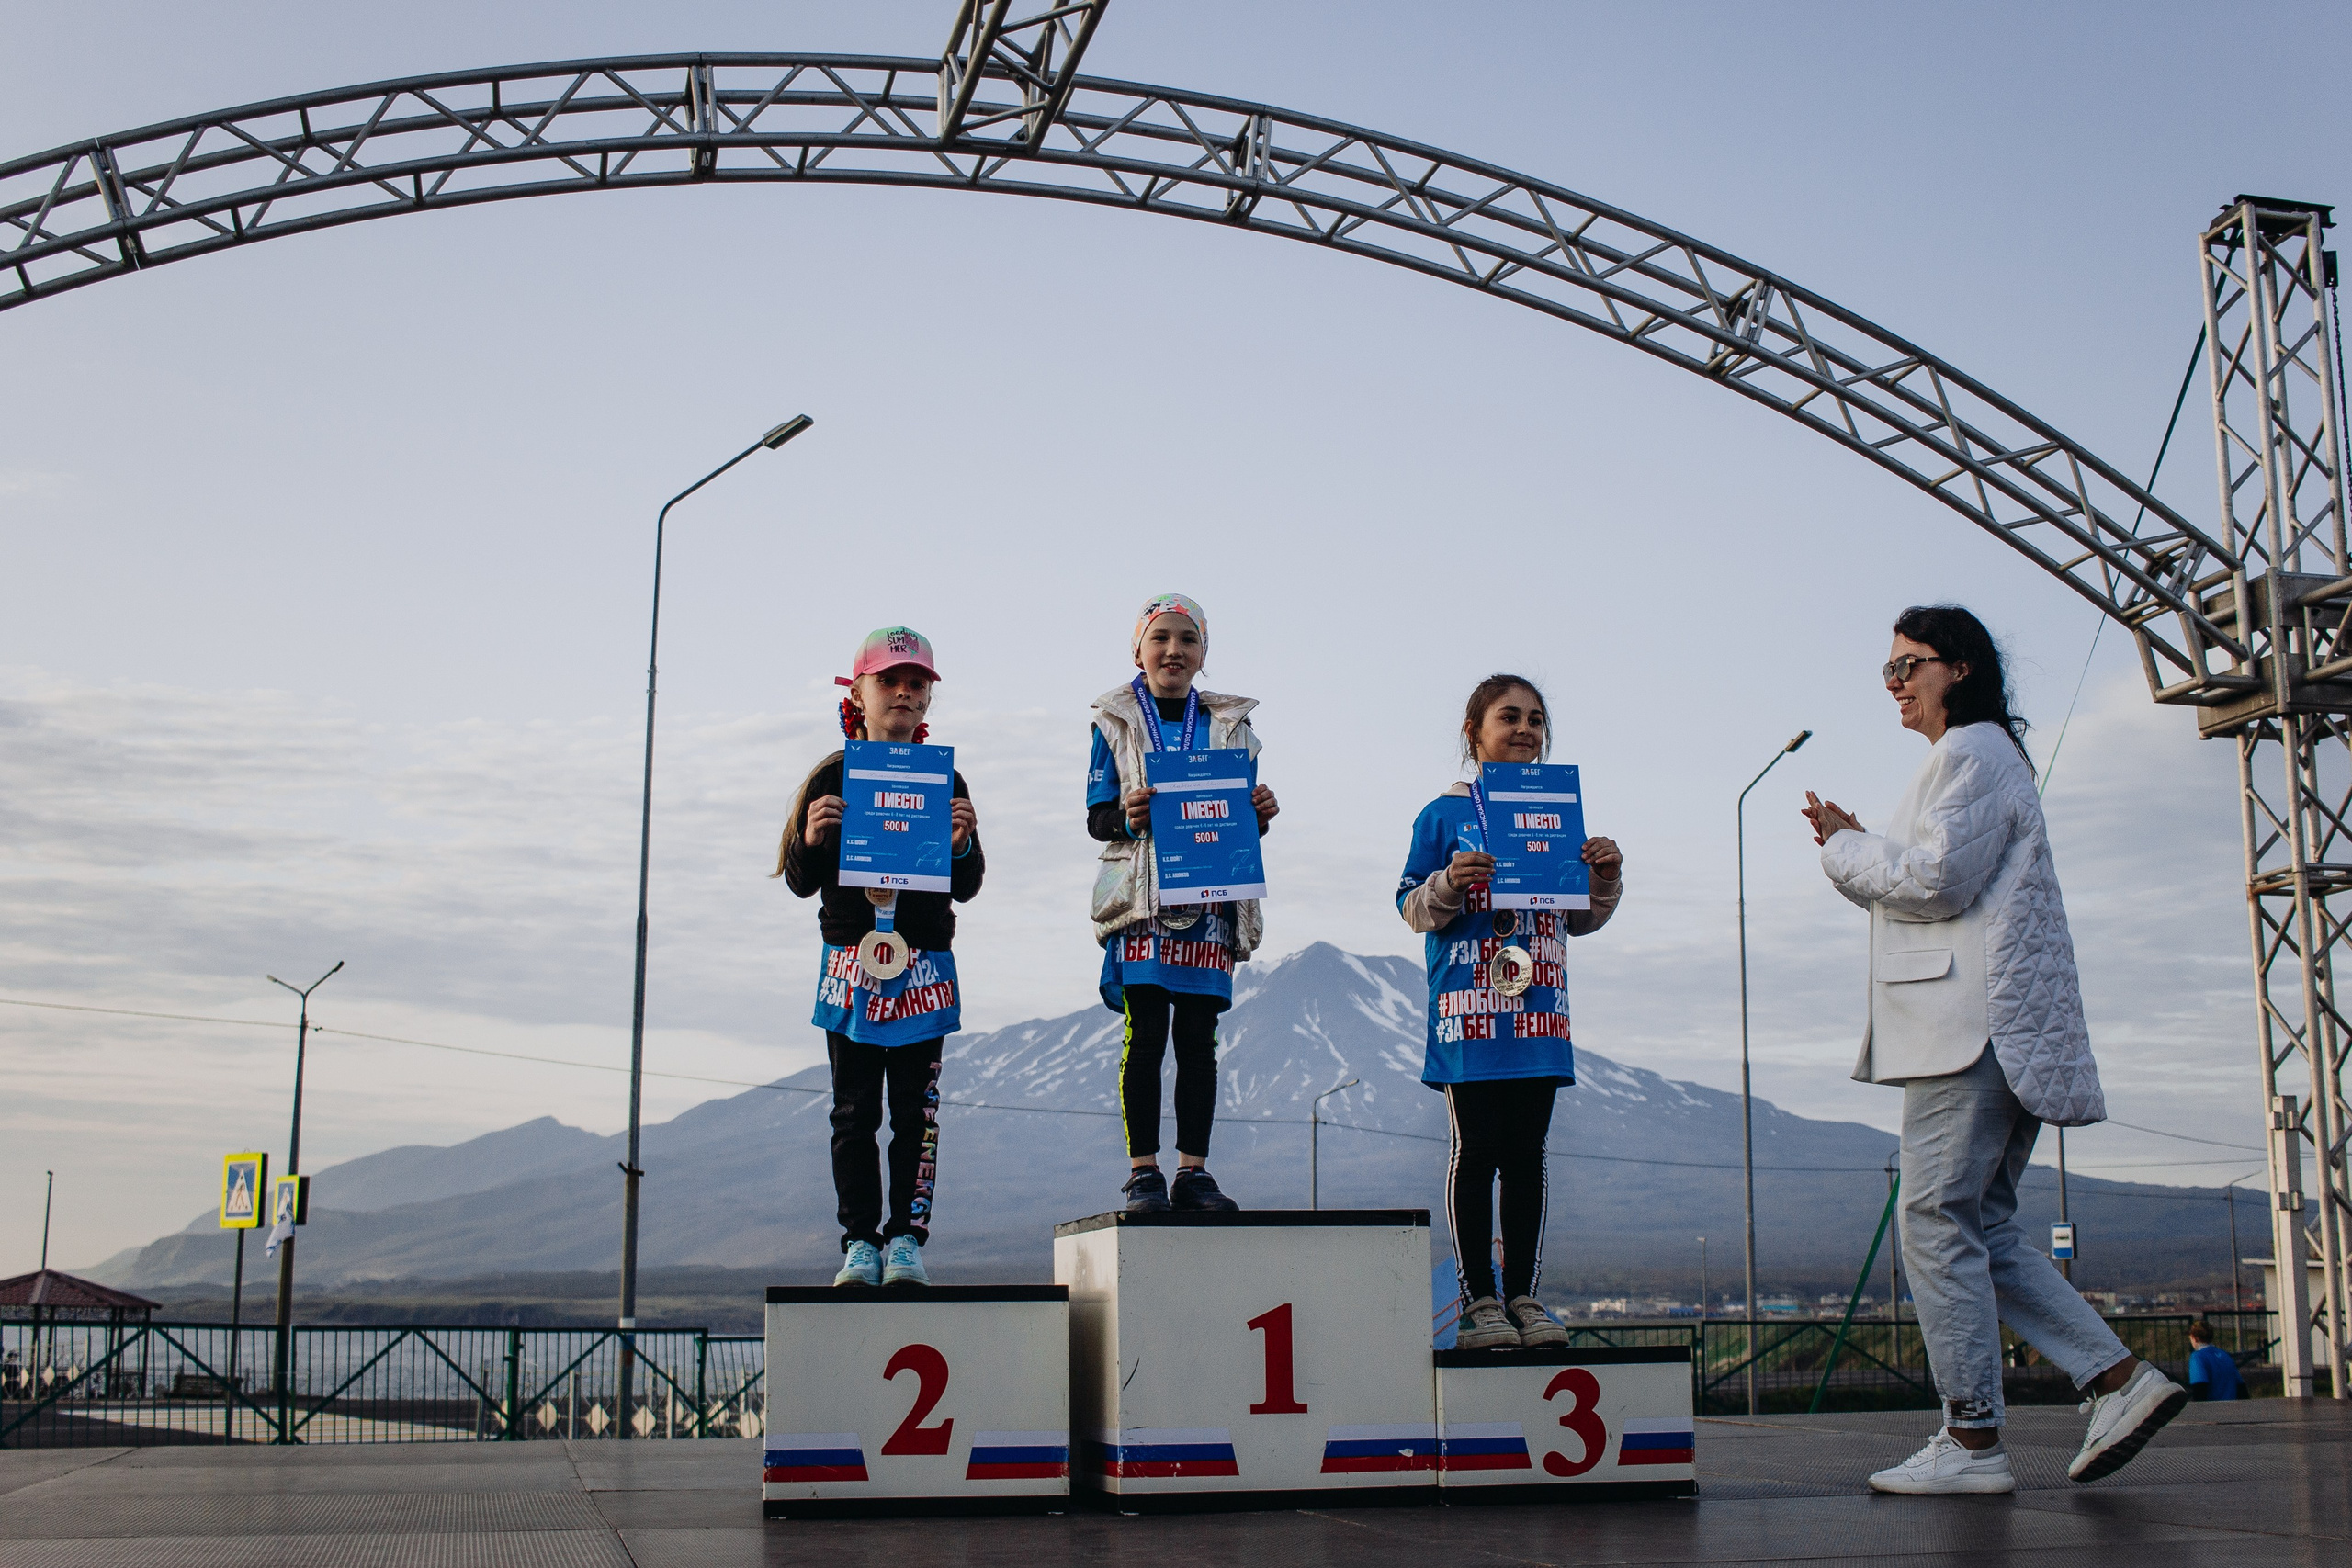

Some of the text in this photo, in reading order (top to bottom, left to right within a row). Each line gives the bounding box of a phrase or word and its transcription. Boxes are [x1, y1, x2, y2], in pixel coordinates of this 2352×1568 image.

[890, 645, 907, 653] MER
[1147, 715, 1163, 752] ХАЛИНСКАЯ
[1183, 734, 1192, 751] ОБЛА
[884, 792, 924, 810] МЕСТО
[1187, 800, 1229, 820] МЕСТО
[884, 820, 900, 831] 500
[1525, 813, 1561, 829] МЕСТО
[1195, 832, 1211, 843] 500
[1527, 841, 1542, 852] 500
[1448, 936, 1503, 966] #ЗАБЕ
[1438, 989, 1525, 1019] #ЛЮБОВЬ
[1436, 1012, 1571, 1043] #ЗАБЕГ #ЕДИНС
[910, 1126, 941, 1229] ENERGY
[1248, 1303, 1307, 1415] 1
[882, 1343, 954, 1456] 2
[1543, 1368, 1608, 1477] 3
